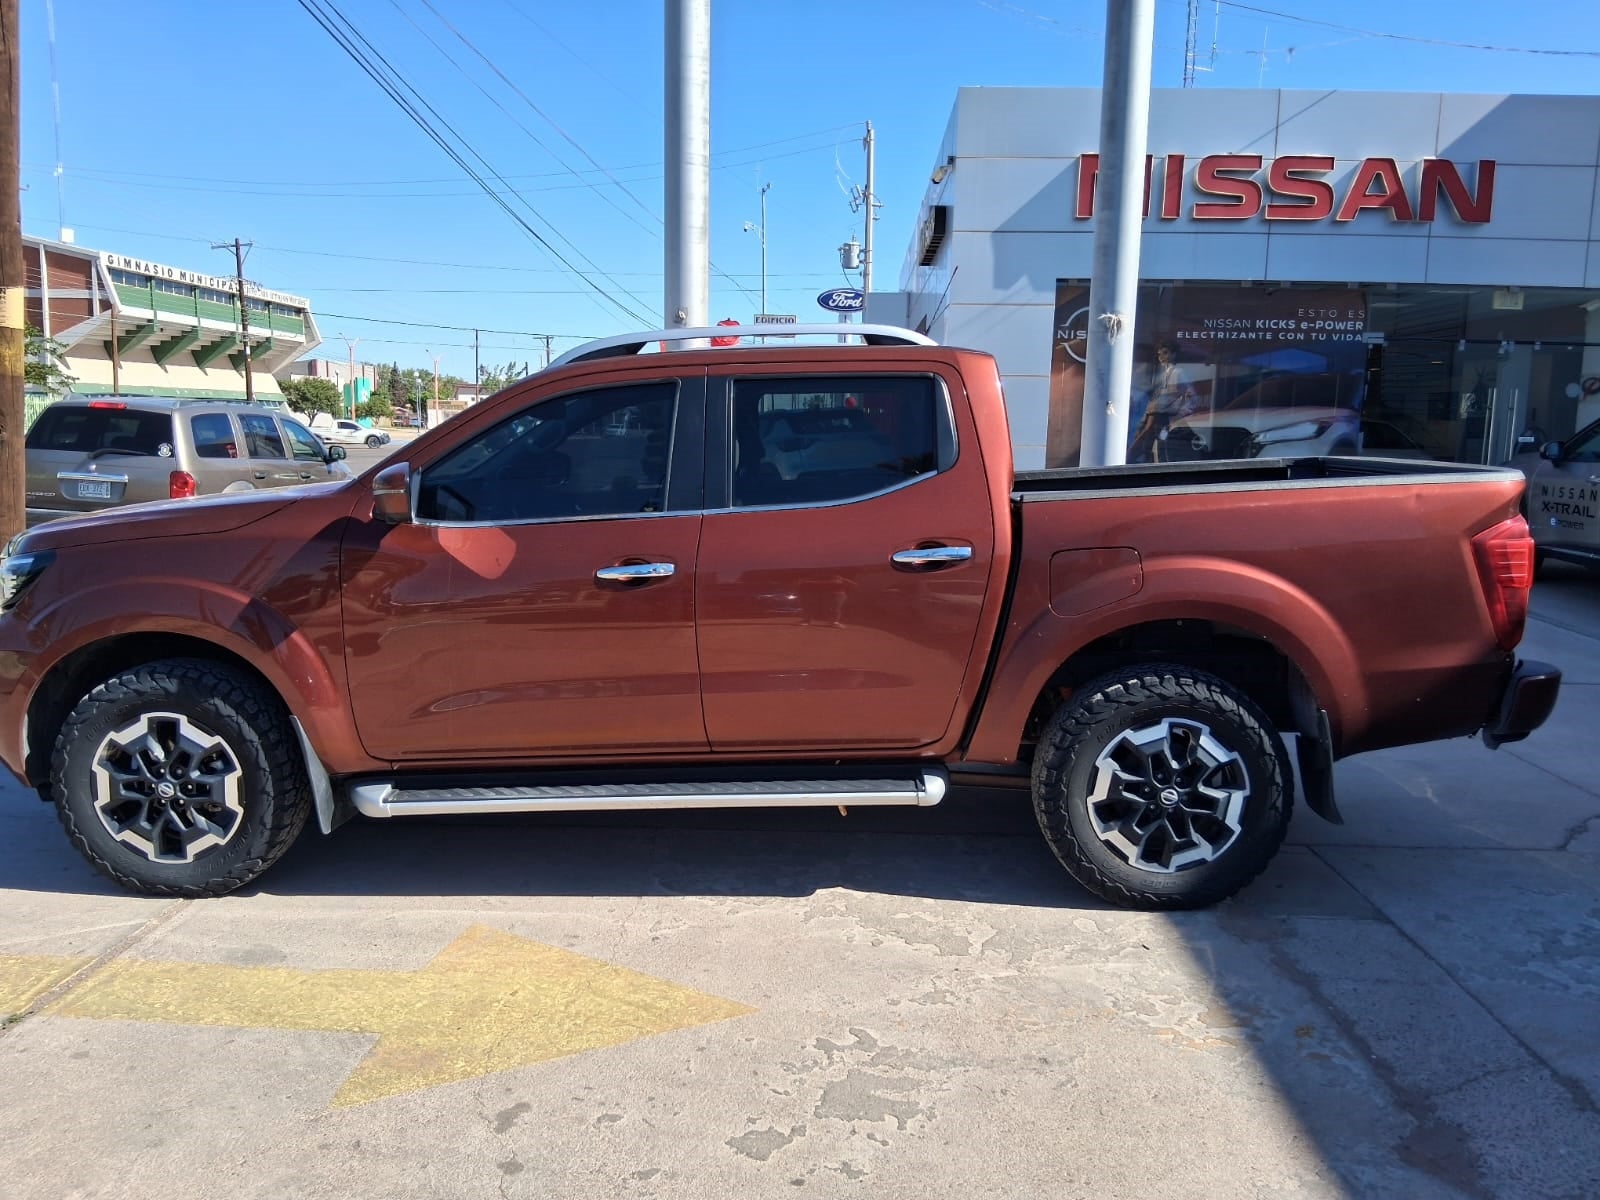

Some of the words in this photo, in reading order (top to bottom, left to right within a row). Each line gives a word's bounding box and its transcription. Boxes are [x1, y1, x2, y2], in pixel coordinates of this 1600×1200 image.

[107, 254, 173, 277] GIMNASIO
[828, 292, 863, 307] Ford
[755, 316, 795, 324] EDIFICIO
[1298, 308, 1338, 318] ESTO
[1348, 309, 1365, 319] ES
[1204, 318, 1251, 329] NISSAN
[1256, 319, 1296, 329] KICKS
[1300, 320, 1364, 331] e-POWER
[1176, 331, 1273, 340] ELECTRIZANTE
[1278, 332, 1305, 340] CON
[1309, 332, 1327, 341] TU
[1332, 333, 1362, 341] VIDA
[1541, 484, 1598, 502] NISSAN
[1541, 501, 1596, 519] X-TRAIL
